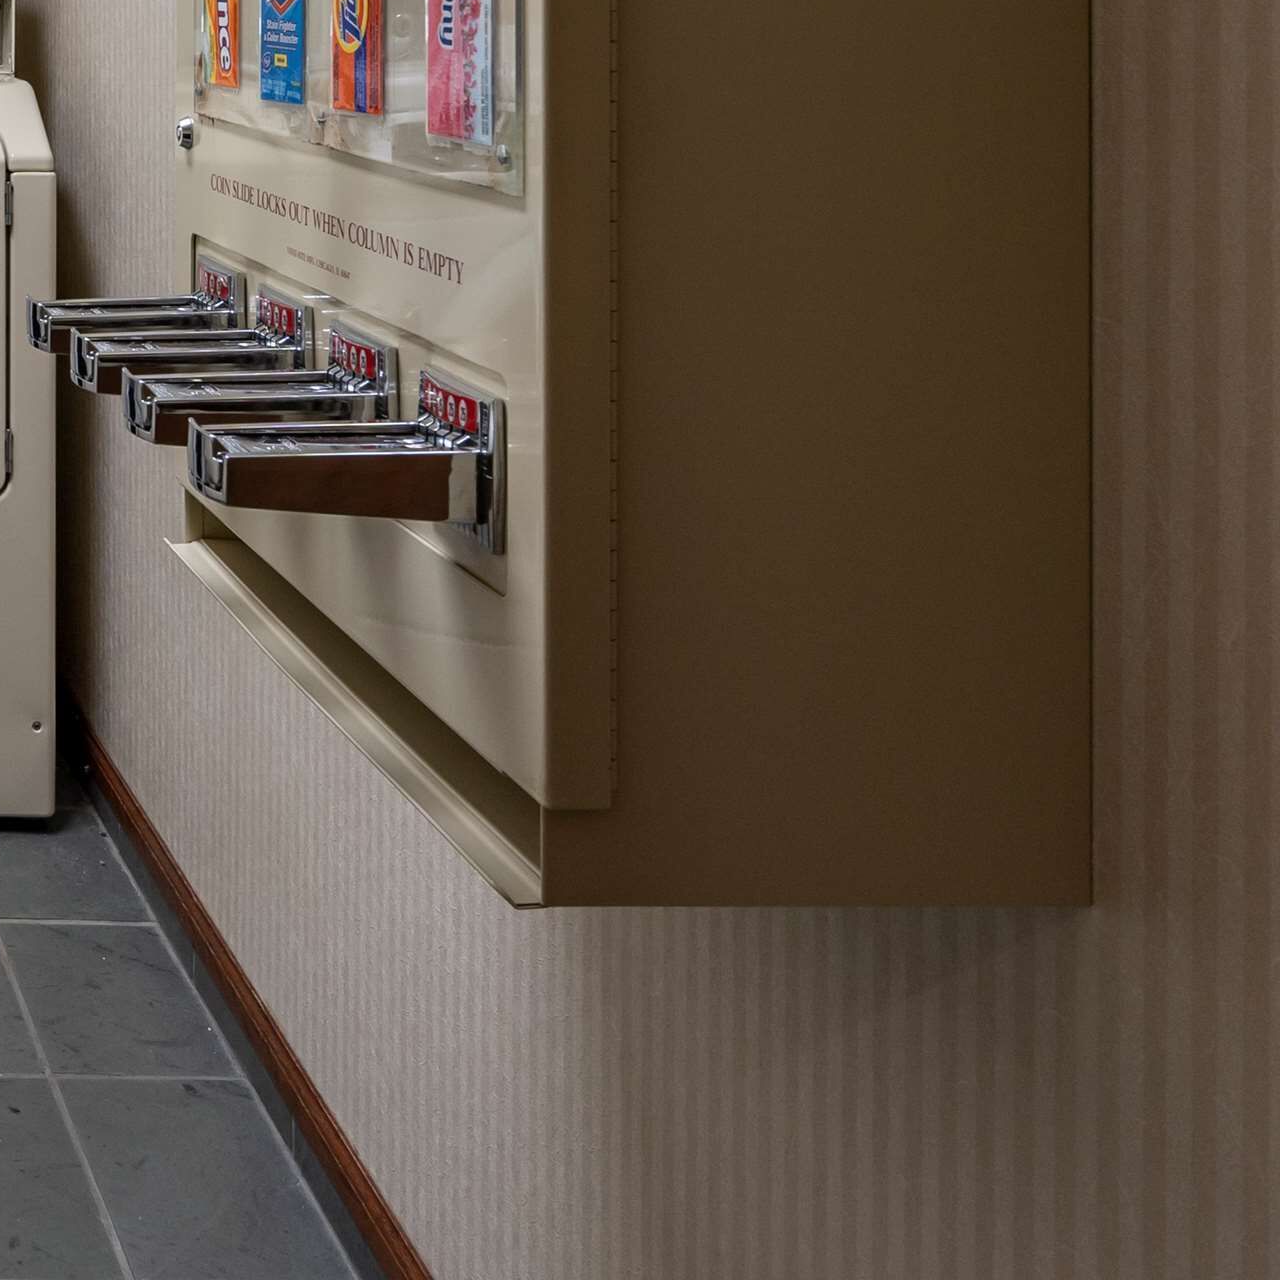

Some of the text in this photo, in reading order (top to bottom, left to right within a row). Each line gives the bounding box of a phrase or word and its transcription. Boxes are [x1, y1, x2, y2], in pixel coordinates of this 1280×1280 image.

[210, 173, 465, 285] COIN SLIDE LOCKS OUT WHEN COLUMN IS EMPTY
